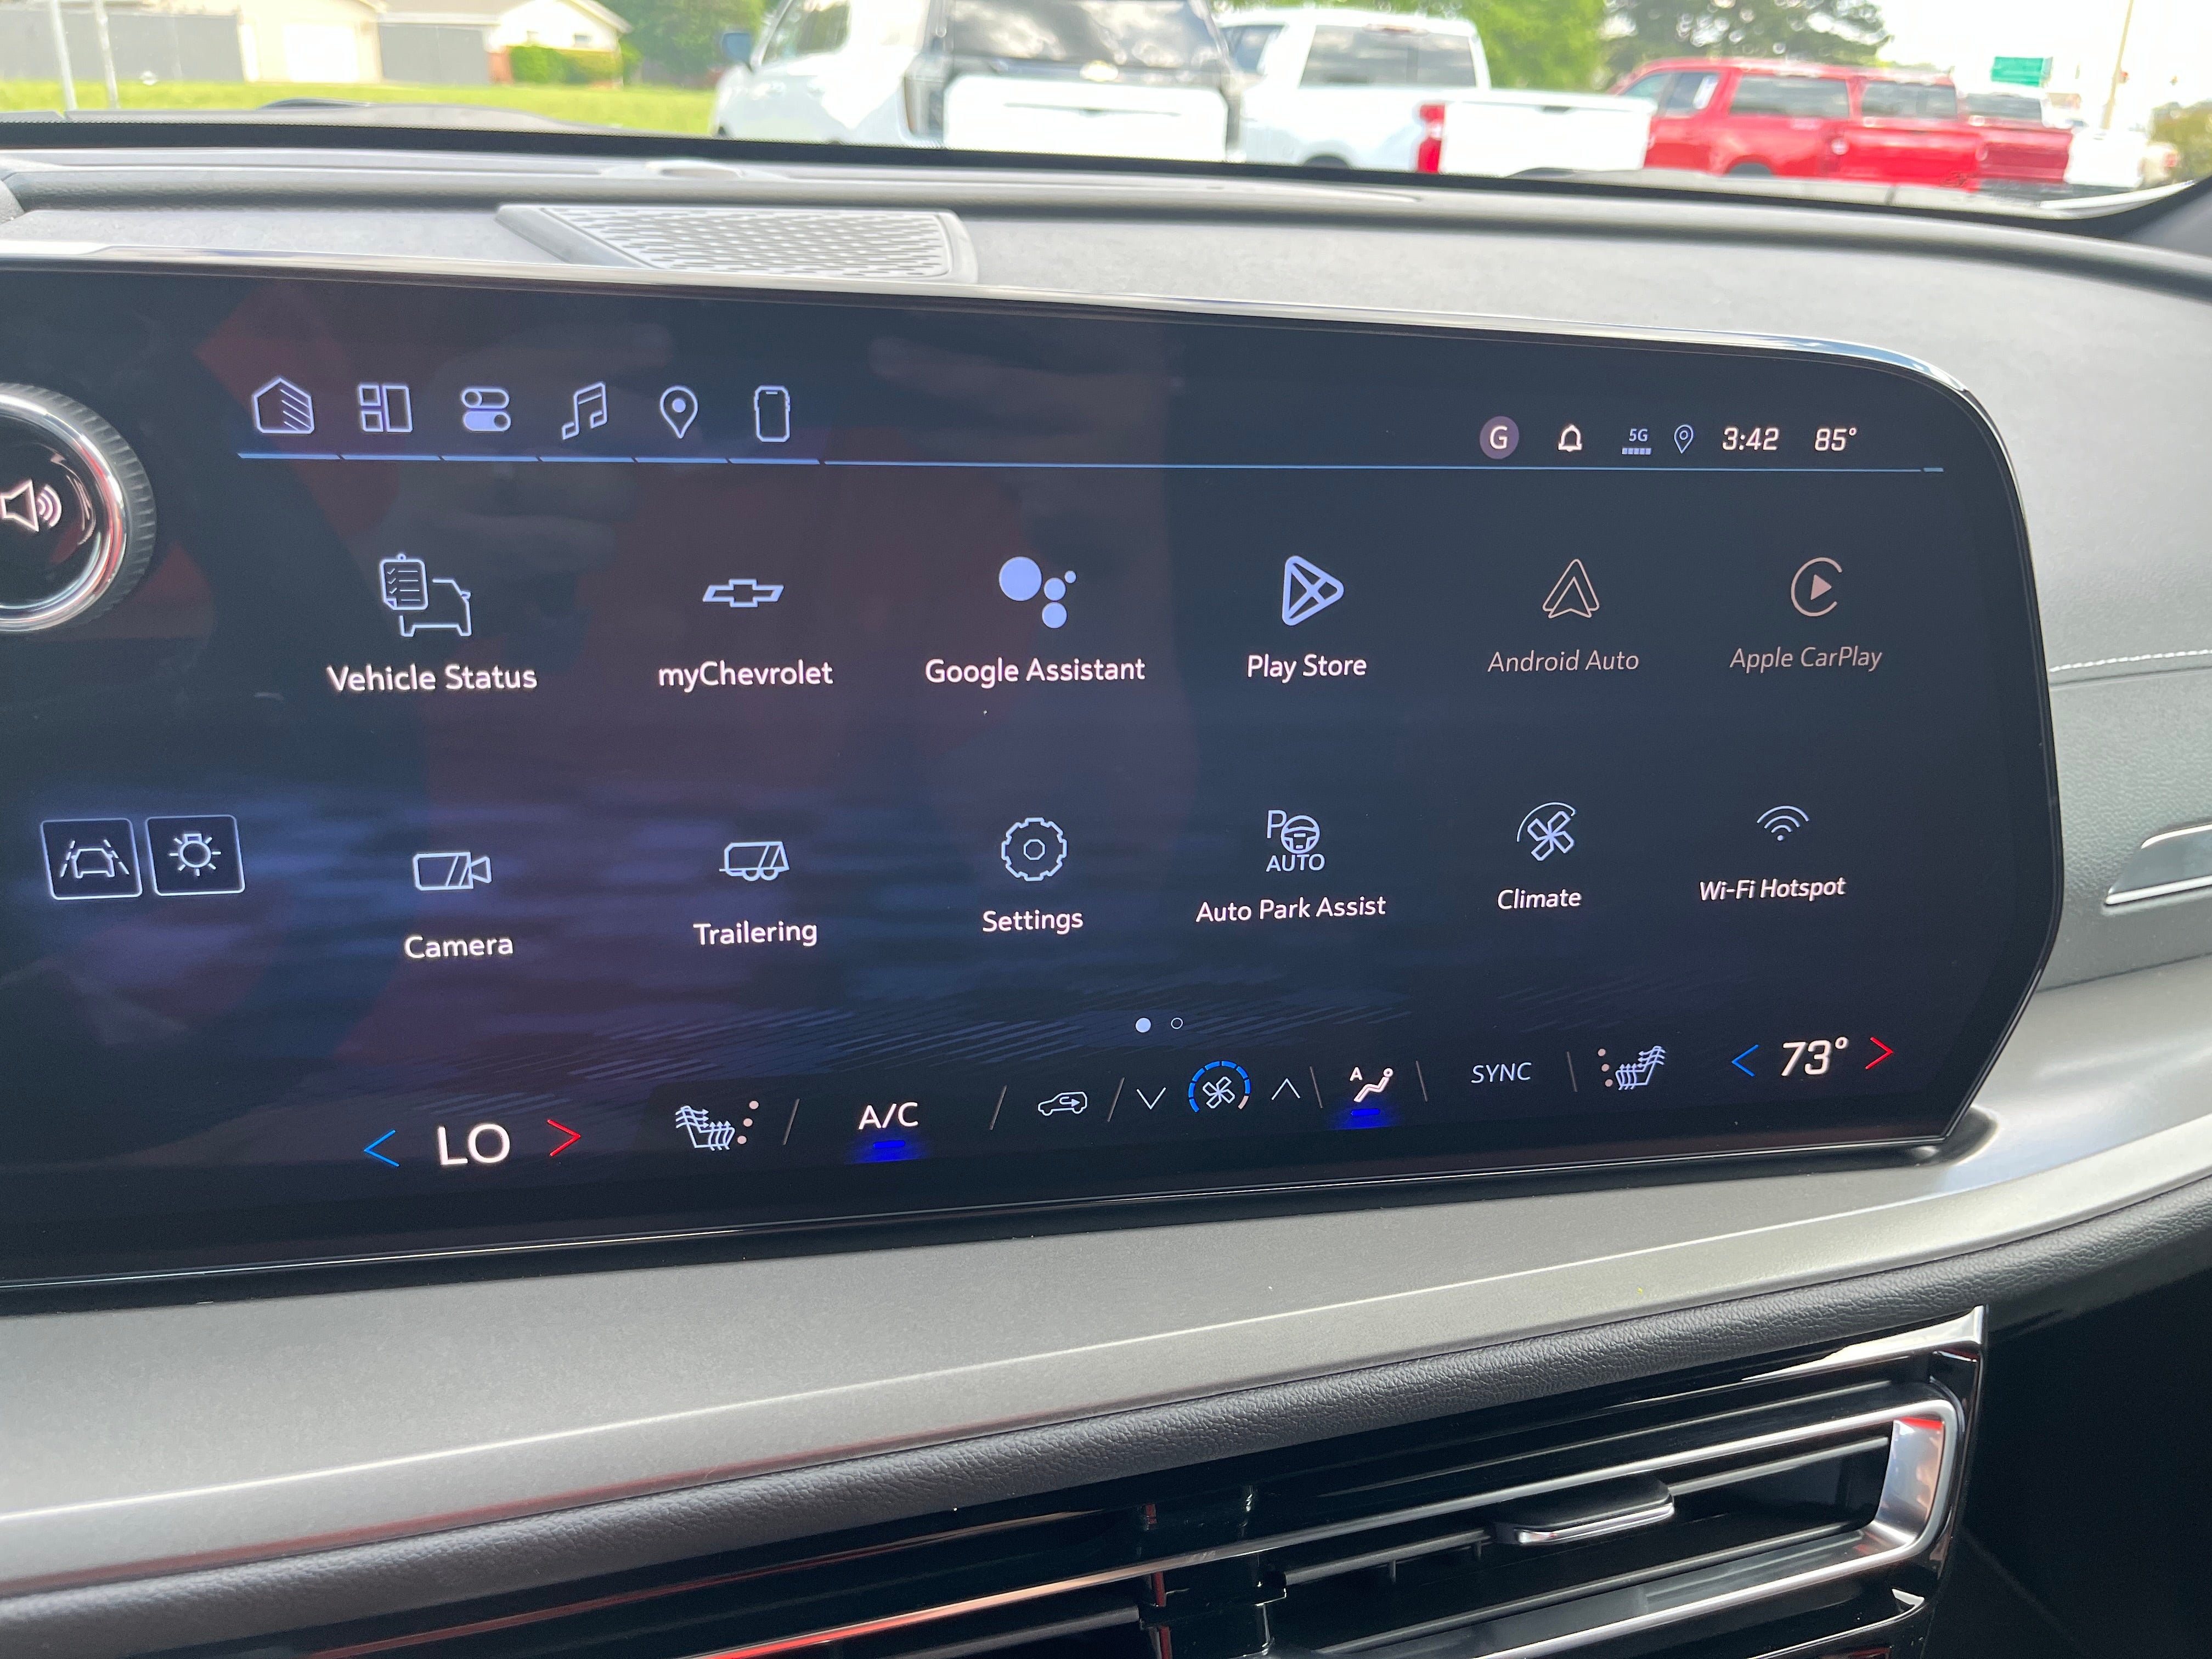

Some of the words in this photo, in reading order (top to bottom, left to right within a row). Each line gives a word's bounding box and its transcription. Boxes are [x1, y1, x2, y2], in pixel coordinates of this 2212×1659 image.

[1489, 425, 1508, 449] G
[1629, 428, 1648, 442] 5G
[1722, 427, 1779, 450] 3:42
[1248, 653, 1297, 684] Play
[1303, 653, 1367, 676] Store
[1487, 649, 1579, 672] Android
[1586, 650, 1639, 670] Auto
[1729, 646, 1793, 674] Apple
[1801, 645, 1882, 672] CarPlay
[326, 663, 436, 691] Vehicle
[444, 664, 537, 690] Status
[658, 659, 833, 693] myChevrolet
[925, 658, 1019, 689] Google
[1026, 658, 1146, 682] Assistant
[1266, 809, 1288, 839] P
[1265, 853, 1325, 872] AUTO
[1498, 888, 1582, 910] Climate
[1700, 879, 1754, 901] Wi-Fi
[1760, 877, 1847, 901] Hotspot
[983, 909, 1084, 935] Settings
[1195, 901, 1252, 922] Auto
[1260, 896, 1311, 919] Park
[1316, 896, 1386, 917] Assist
[404, 935, 514, 958] Camera
[693, 920, 817, 947] Trailering
[1349, 1066, 1363, 1081] A
[1471, 1062, 1532, 1084] SYNC
[858, 1102, 918, 1130] A/C
[437, 1123, 510, 1166] LO
